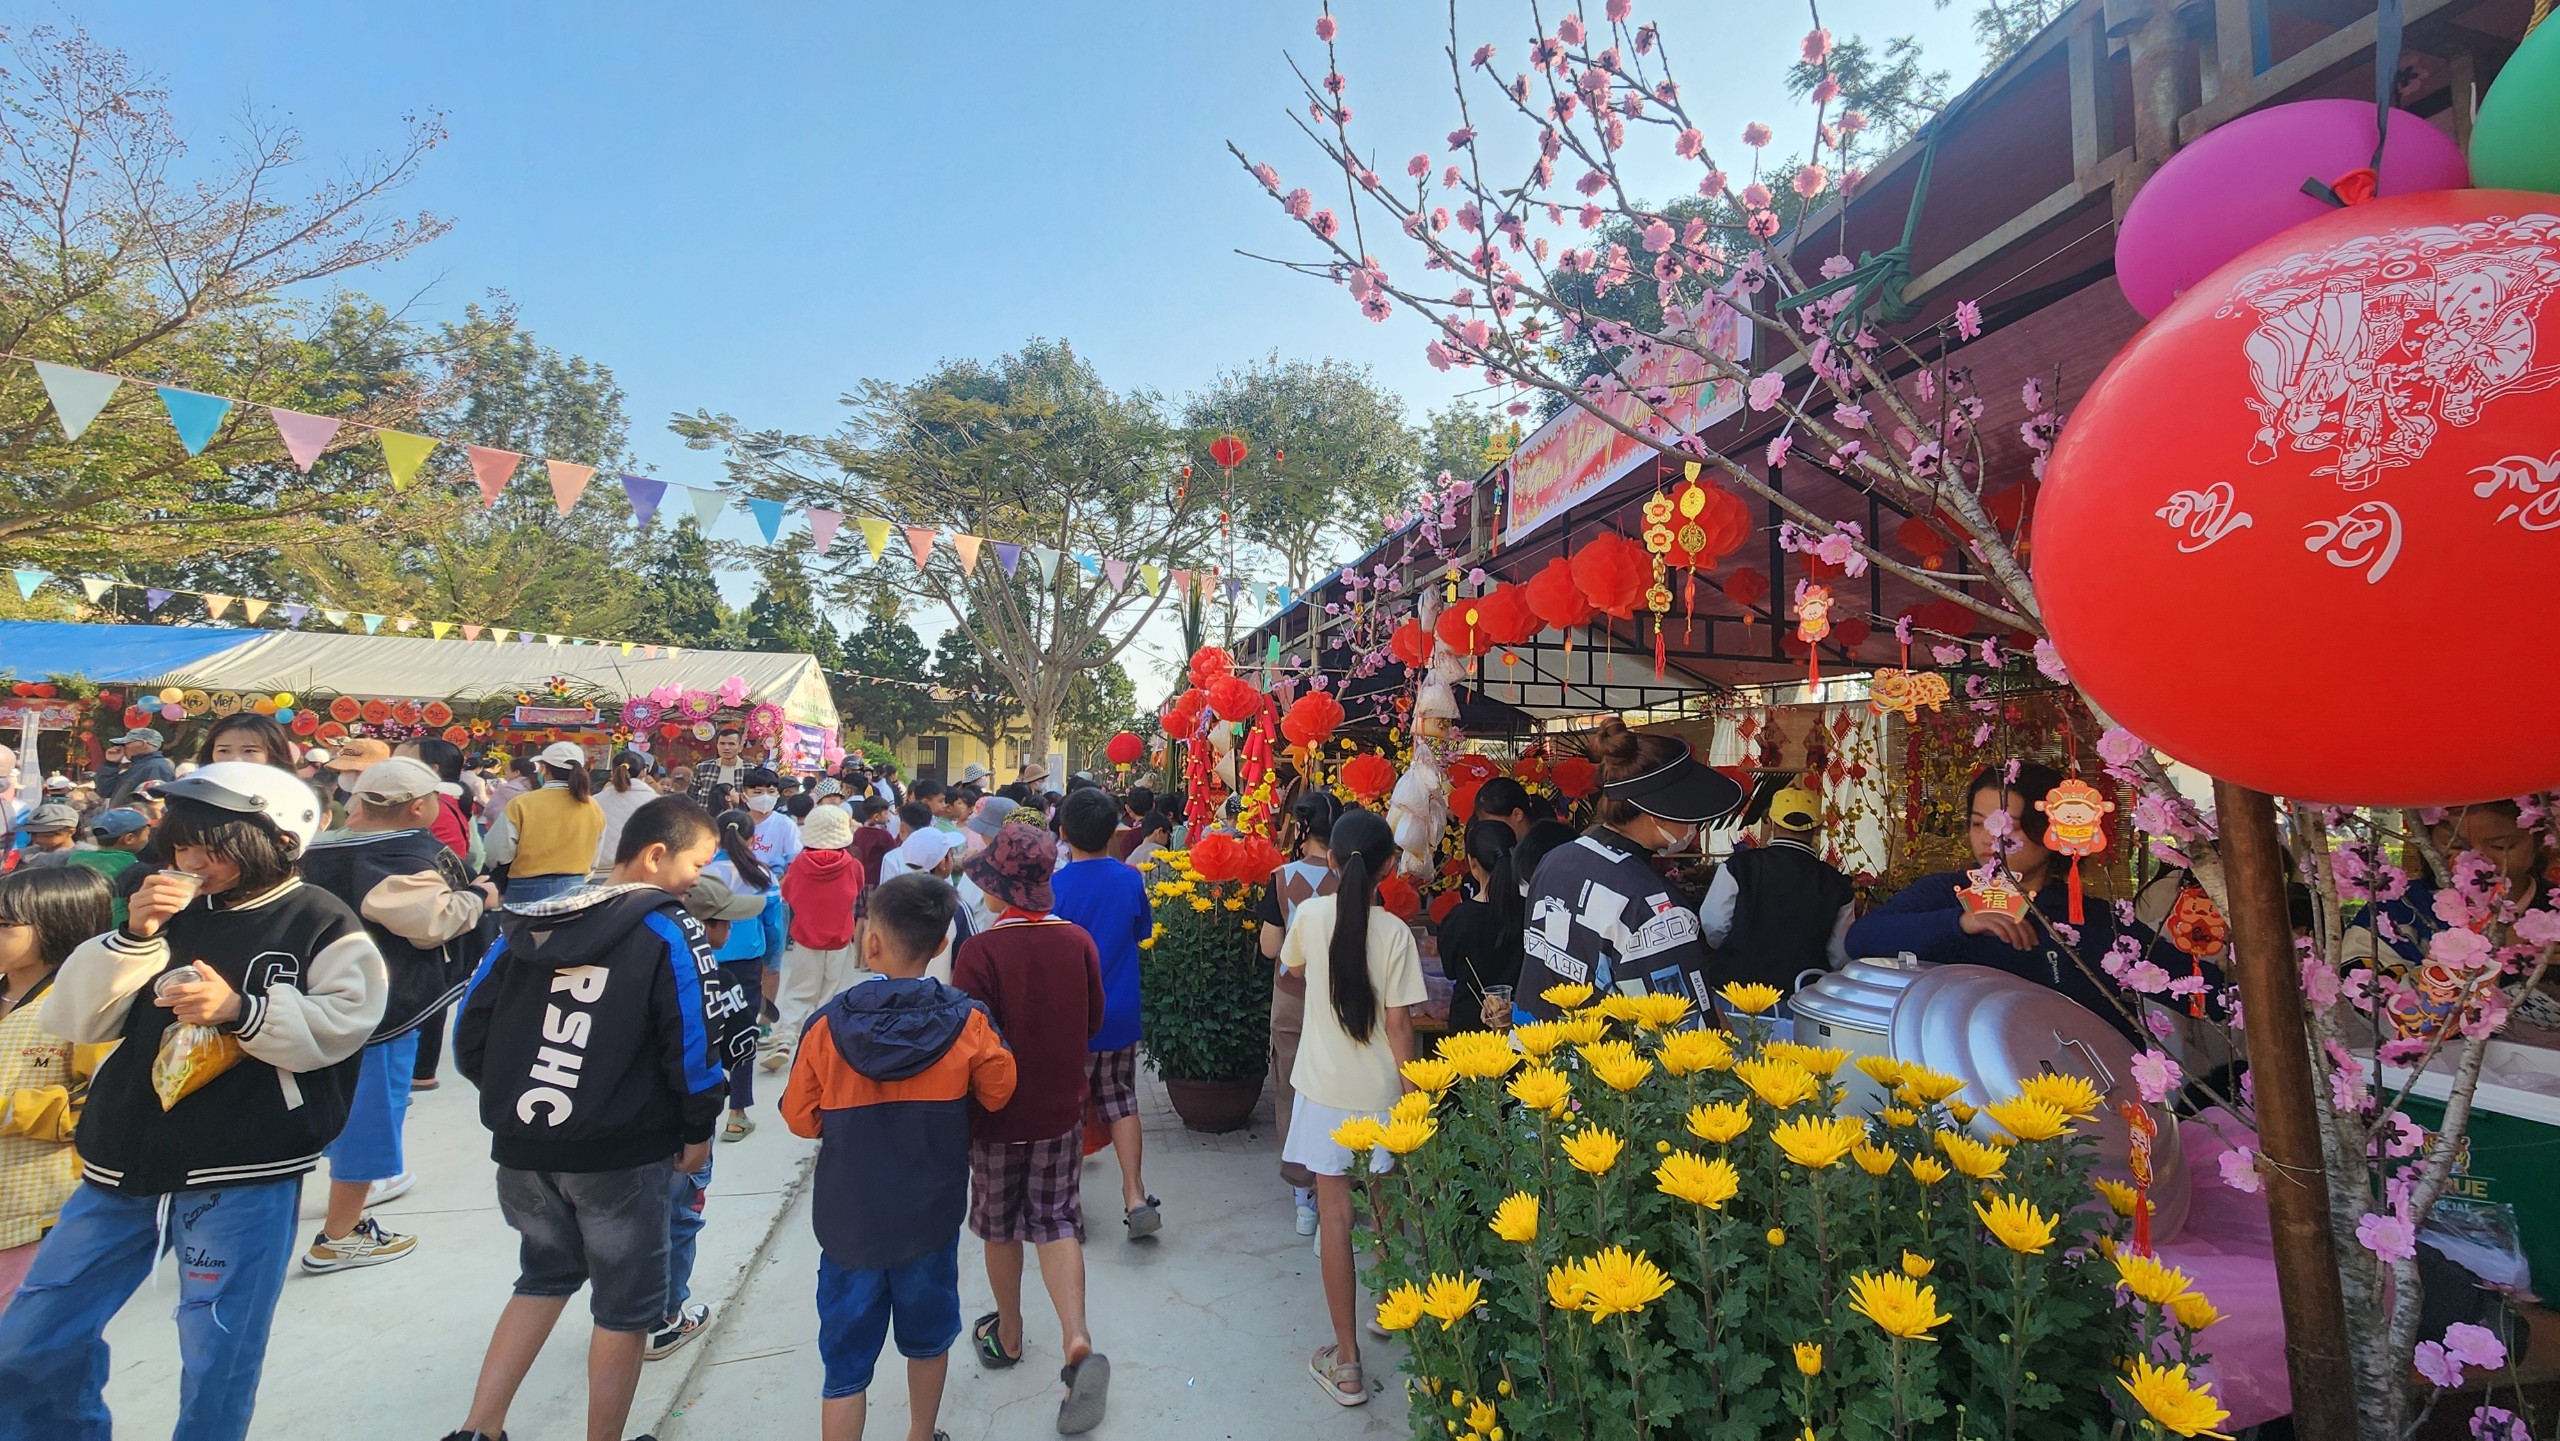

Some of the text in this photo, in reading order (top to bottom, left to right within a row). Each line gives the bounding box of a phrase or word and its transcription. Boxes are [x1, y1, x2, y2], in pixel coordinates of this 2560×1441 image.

[1982, 890, 2008, 910] 福
[516, 964, 610, 1127] RSHC
[34, 1056, 50, 1068] M
[184, 1246, 227, 1268] Fashion
